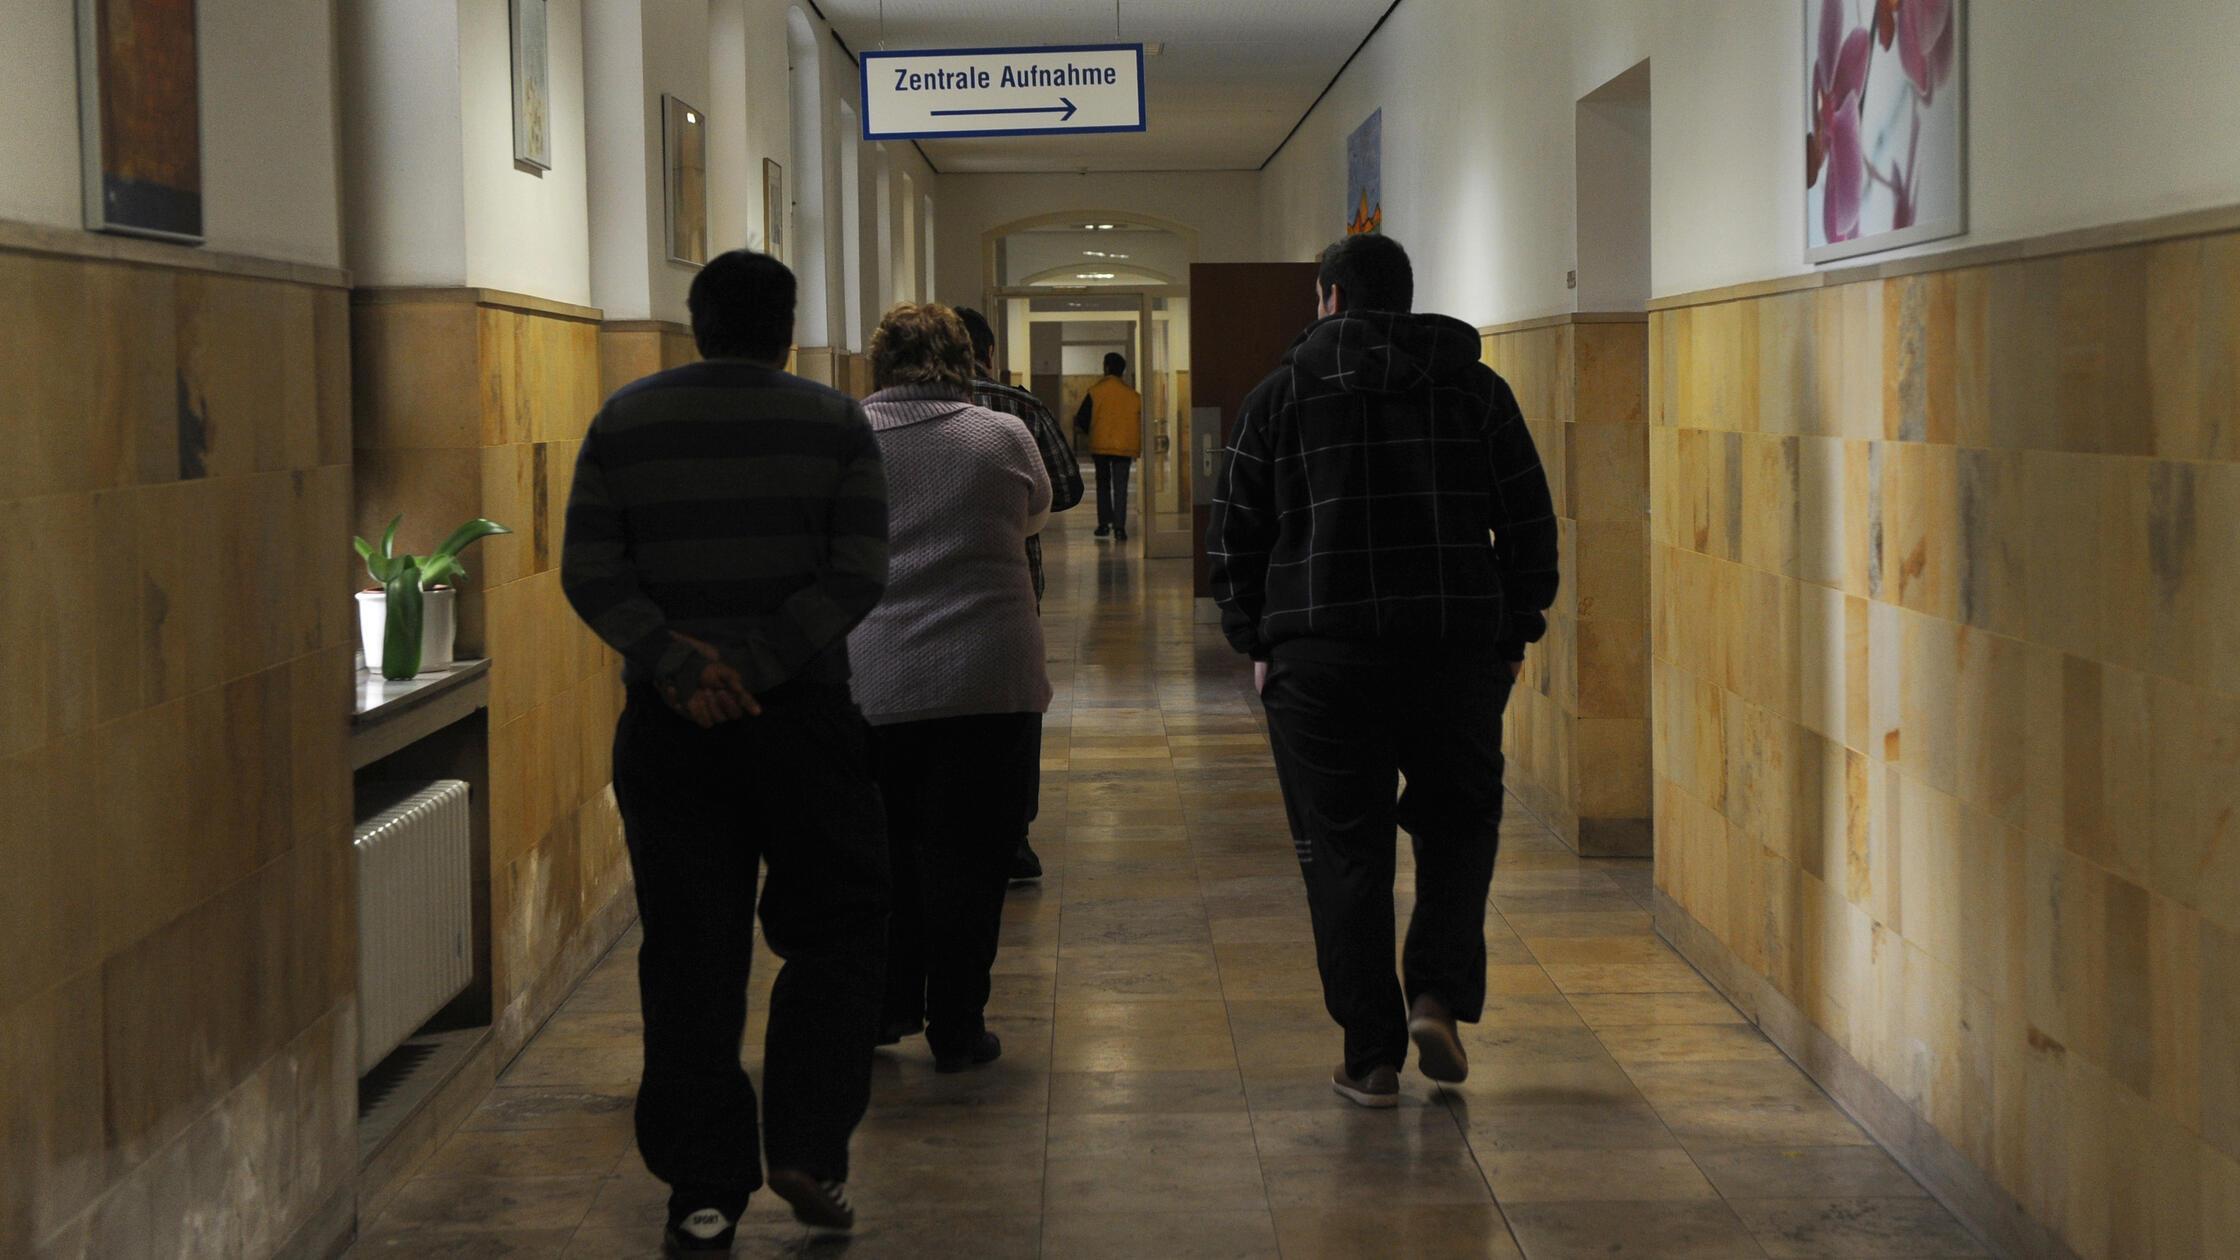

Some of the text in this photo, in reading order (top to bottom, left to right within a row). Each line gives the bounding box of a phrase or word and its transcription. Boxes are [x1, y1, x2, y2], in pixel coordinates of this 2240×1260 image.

[894, 63, 1116, 91] Zentrale Aufnahme
[693, 1215, 718, 1225] SPORT
